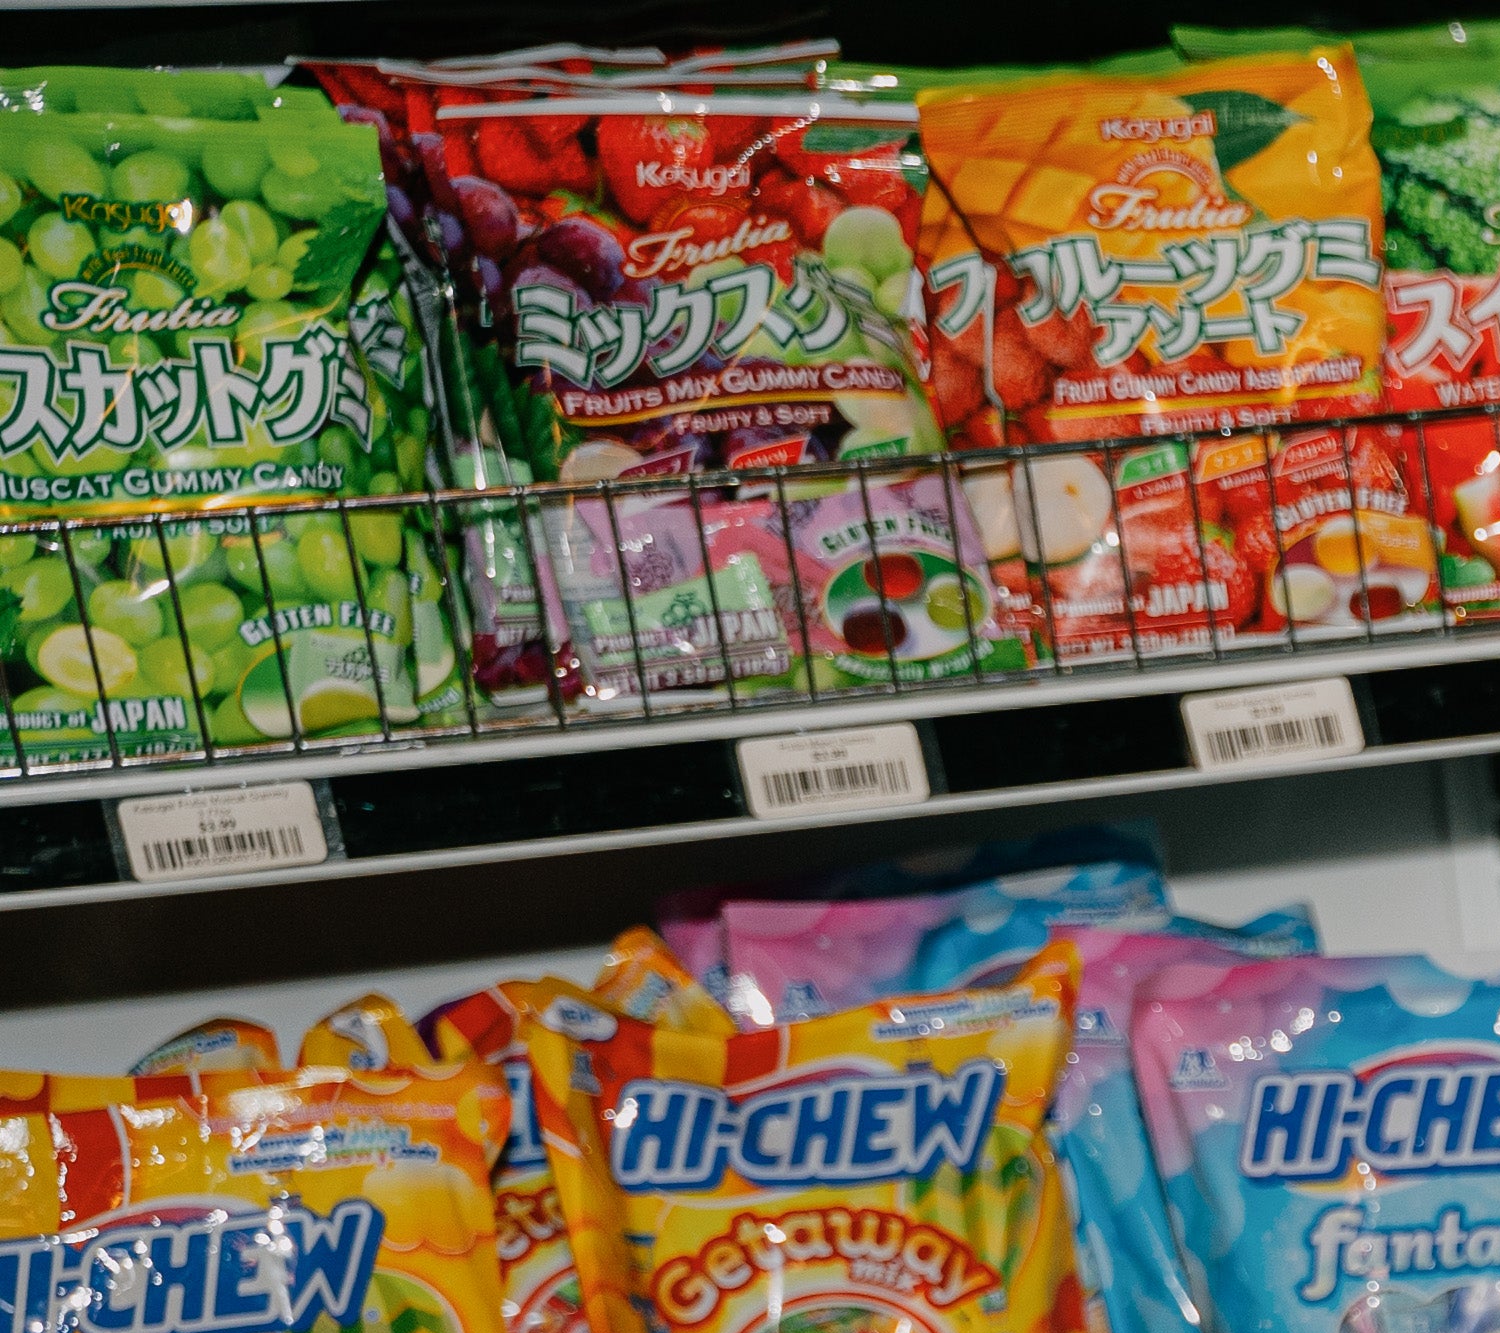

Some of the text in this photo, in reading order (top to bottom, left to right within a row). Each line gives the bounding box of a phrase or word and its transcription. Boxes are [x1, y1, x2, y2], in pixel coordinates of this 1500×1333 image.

[1101, 111, 1217, 143] Kasugai
[635, 160, 751, 197] Kasugai
[1088, 183, 1251, 231] Frutia
[624, 216, 792, 278] Frutia
[43, 281, 241, 335] Frutia
[1095, 299, 1305, 367] アソート
[563, 368, 821, 417] FRUITS MIX GUMMY
[1055, 376, 1107, 405] FRUIT
[1111, 372, 1177, 401] GUMMY
[1179, 366, 1243, 395] CANDY
[123, 463, 344, 496] GUMMY CANDY
[239, 603, 332, 647] GLUTEN
[91, 696, 187, 734] JAPAN
[611, 1056, 1005, 1193] HI-CHEW
[652, 1207, 999, 1327] Getaway
[849, 1258, 917, 1292] mix
